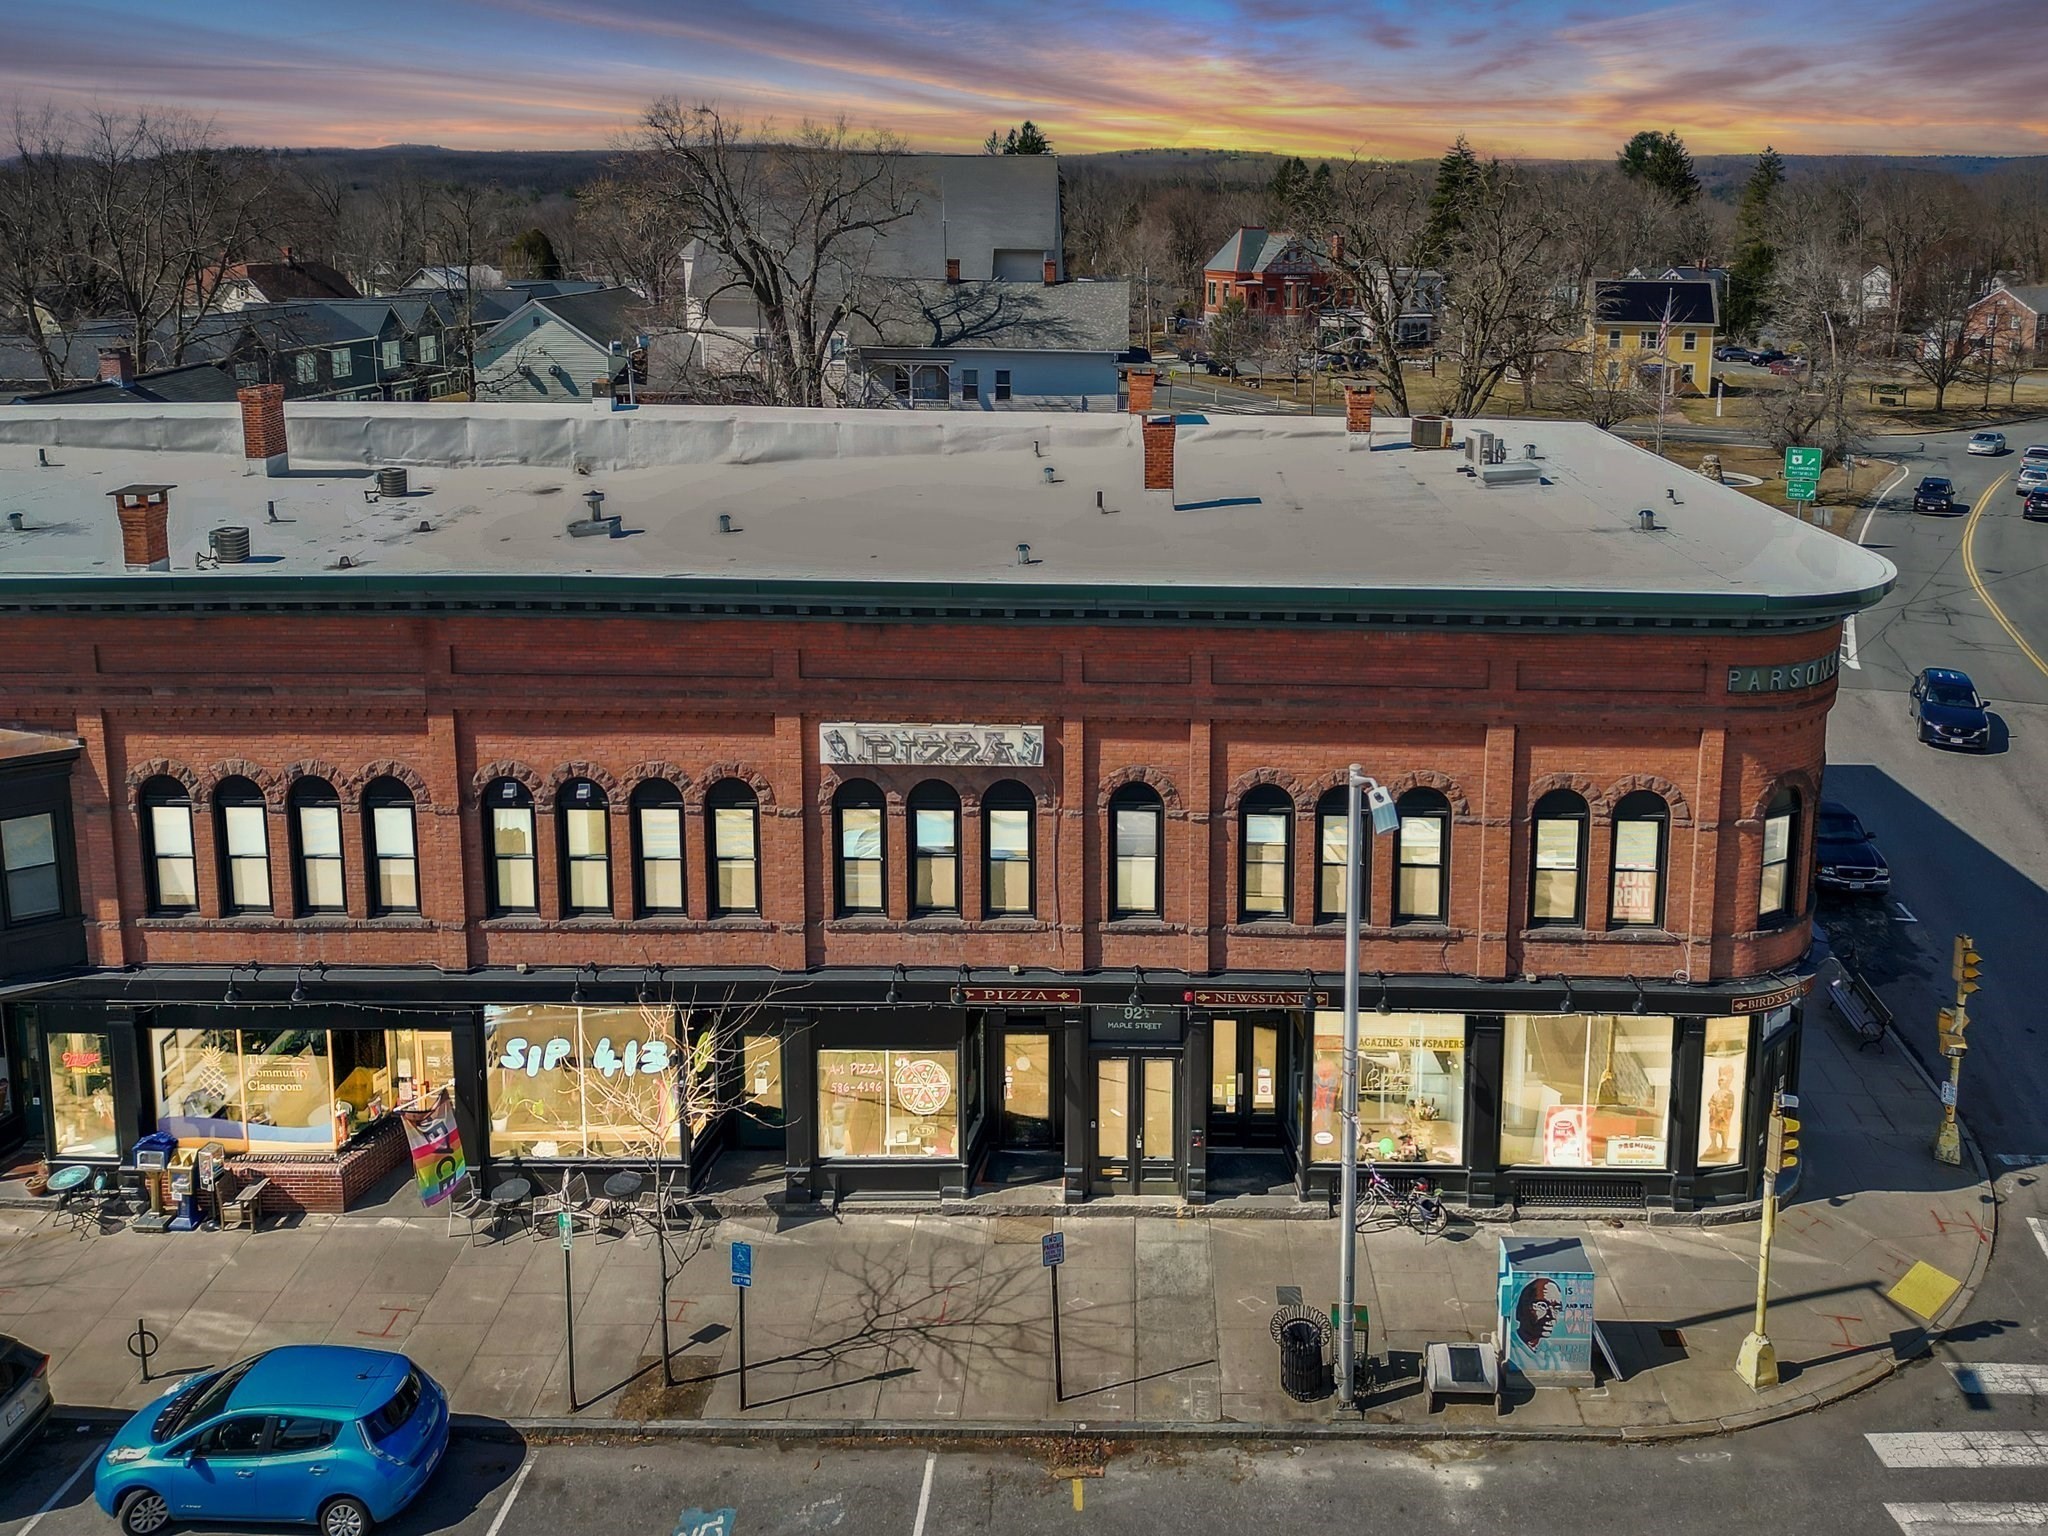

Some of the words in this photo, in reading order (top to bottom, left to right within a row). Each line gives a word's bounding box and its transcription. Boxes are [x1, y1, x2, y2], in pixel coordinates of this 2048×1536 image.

[1615, 887, 1651, 907] RENT
[983, 990, 1048, 1000] PIZZA
[1748, 995, 1783, 1009] BIRD'S
[1135, 1022, 1162, 1030] STREET
[1358, 1037, 1404, 1048] AGAZINES
[1409, 1038, 1464, 1049] NEWSPAPERS
[245, 1054, 268, 1065] The
[500, 1037, 571, 1077] SIP
[593, 1037, 670, 1078] 413
[247, 1066, 310, 1080] Community
[829, 1063, 845, 1075] A-1
[851, 1062, 885, 1076] PIZZA
[247, 1080, 303, 1091] Classroom
[831, 1081, 882, 1093] 586-4196
[912, 1126, 936, 1136] ATM
[1618, 1142, 1656, 1151] PREMIUM
[1044, 1242, 1063, 1250] PARKING
[1564, 1287, 1574, 1296] IS
